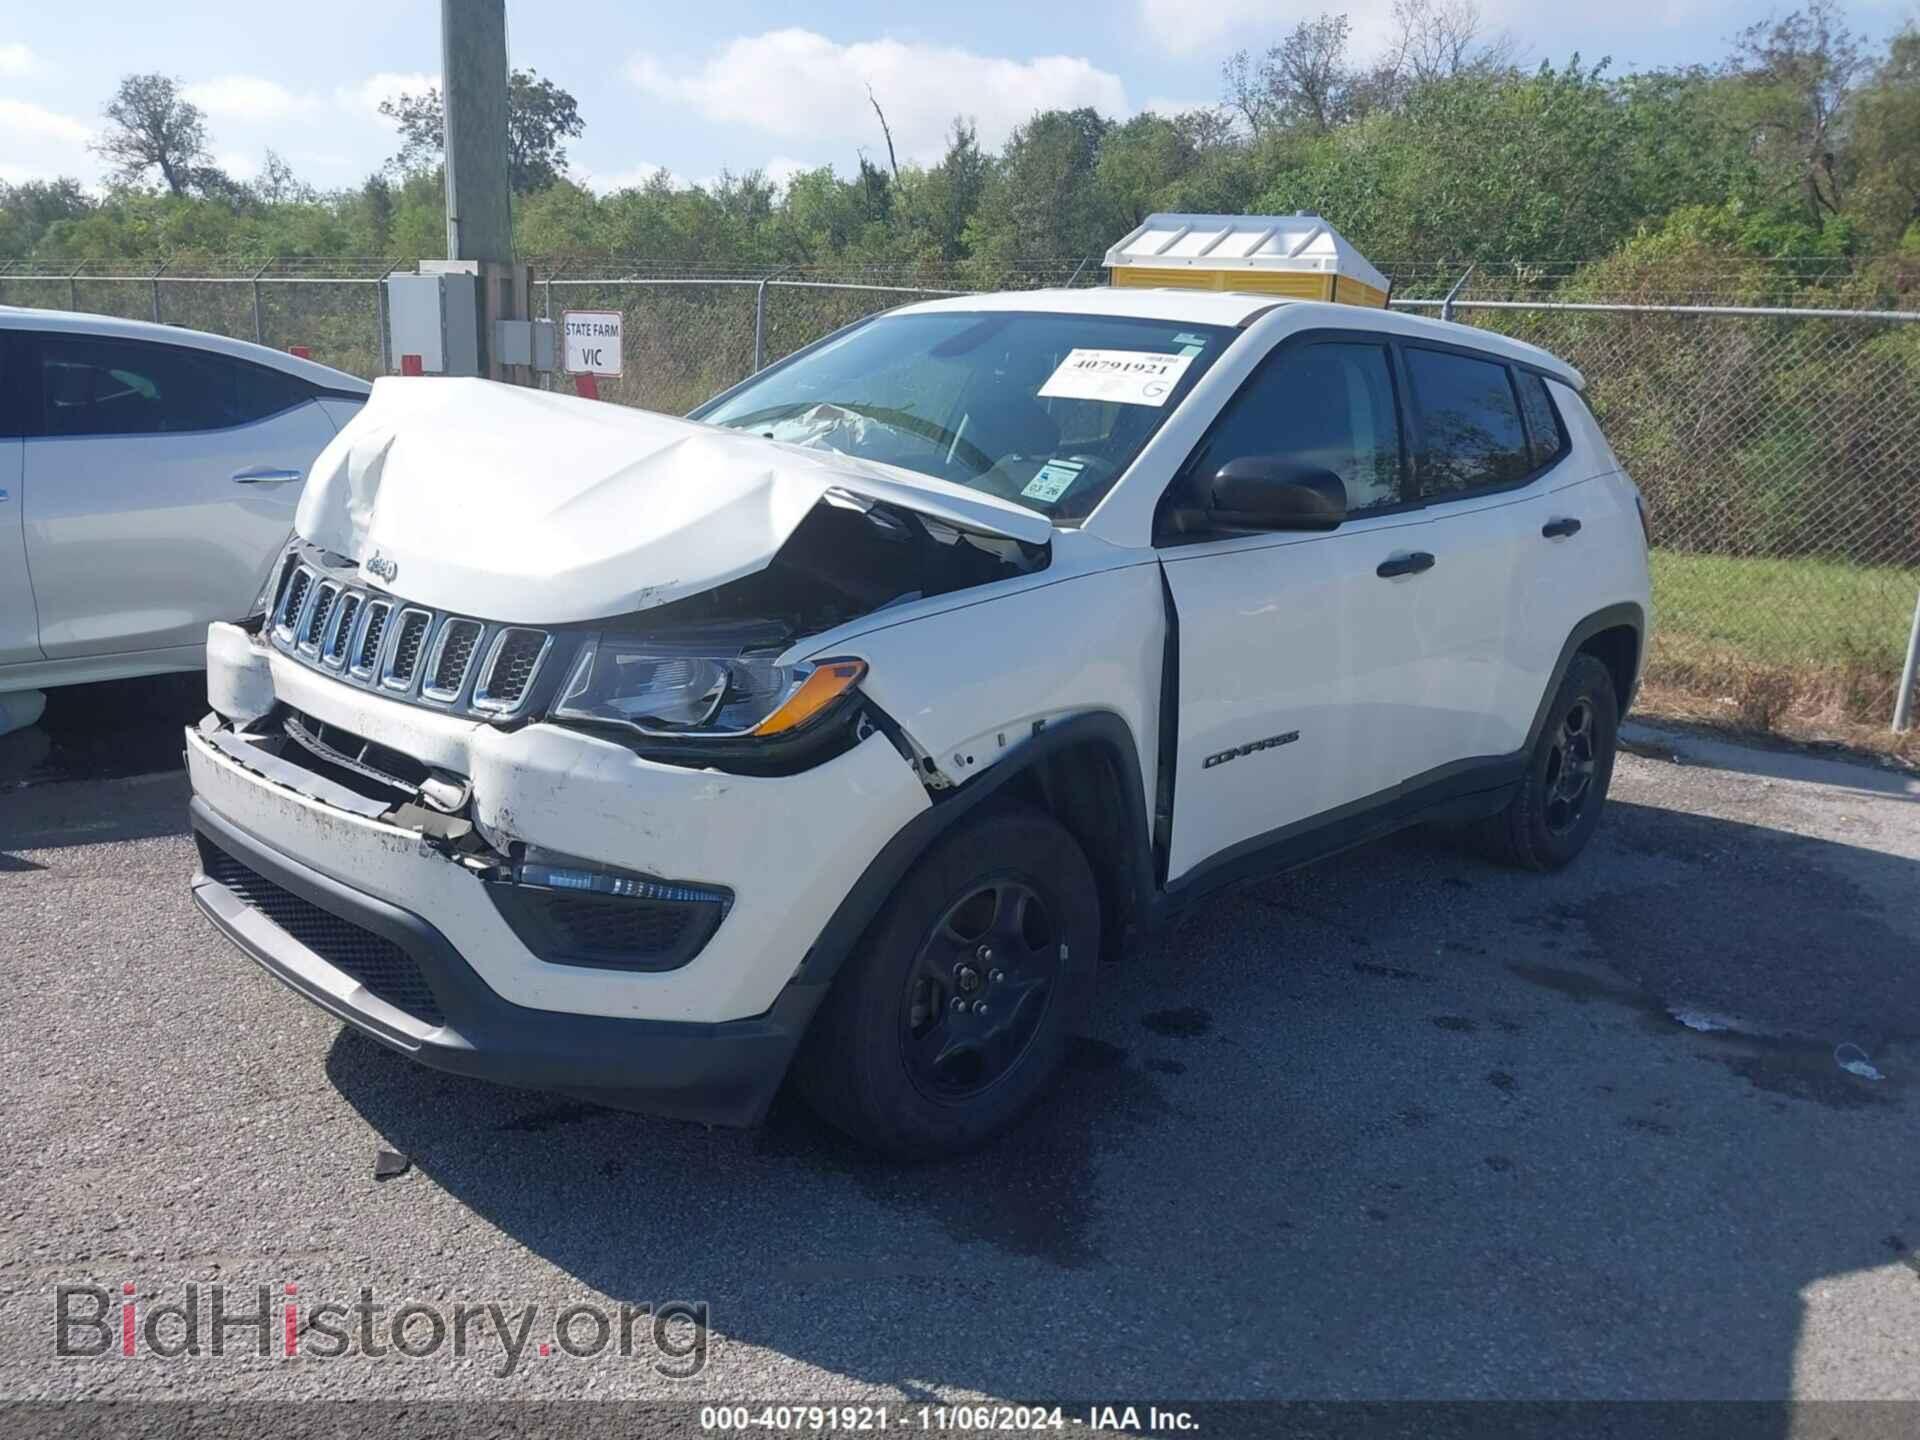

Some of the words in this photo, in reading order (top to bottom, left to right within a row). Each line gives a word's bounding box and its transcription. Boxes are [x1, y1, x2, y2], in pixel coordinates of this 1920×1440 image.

[565, 323, 591, 336] STATE
[593, 324, 619, 337] FARM
[582, 347, 602, 366] VIC
[1073, 359, 1168, 375] 40791921
